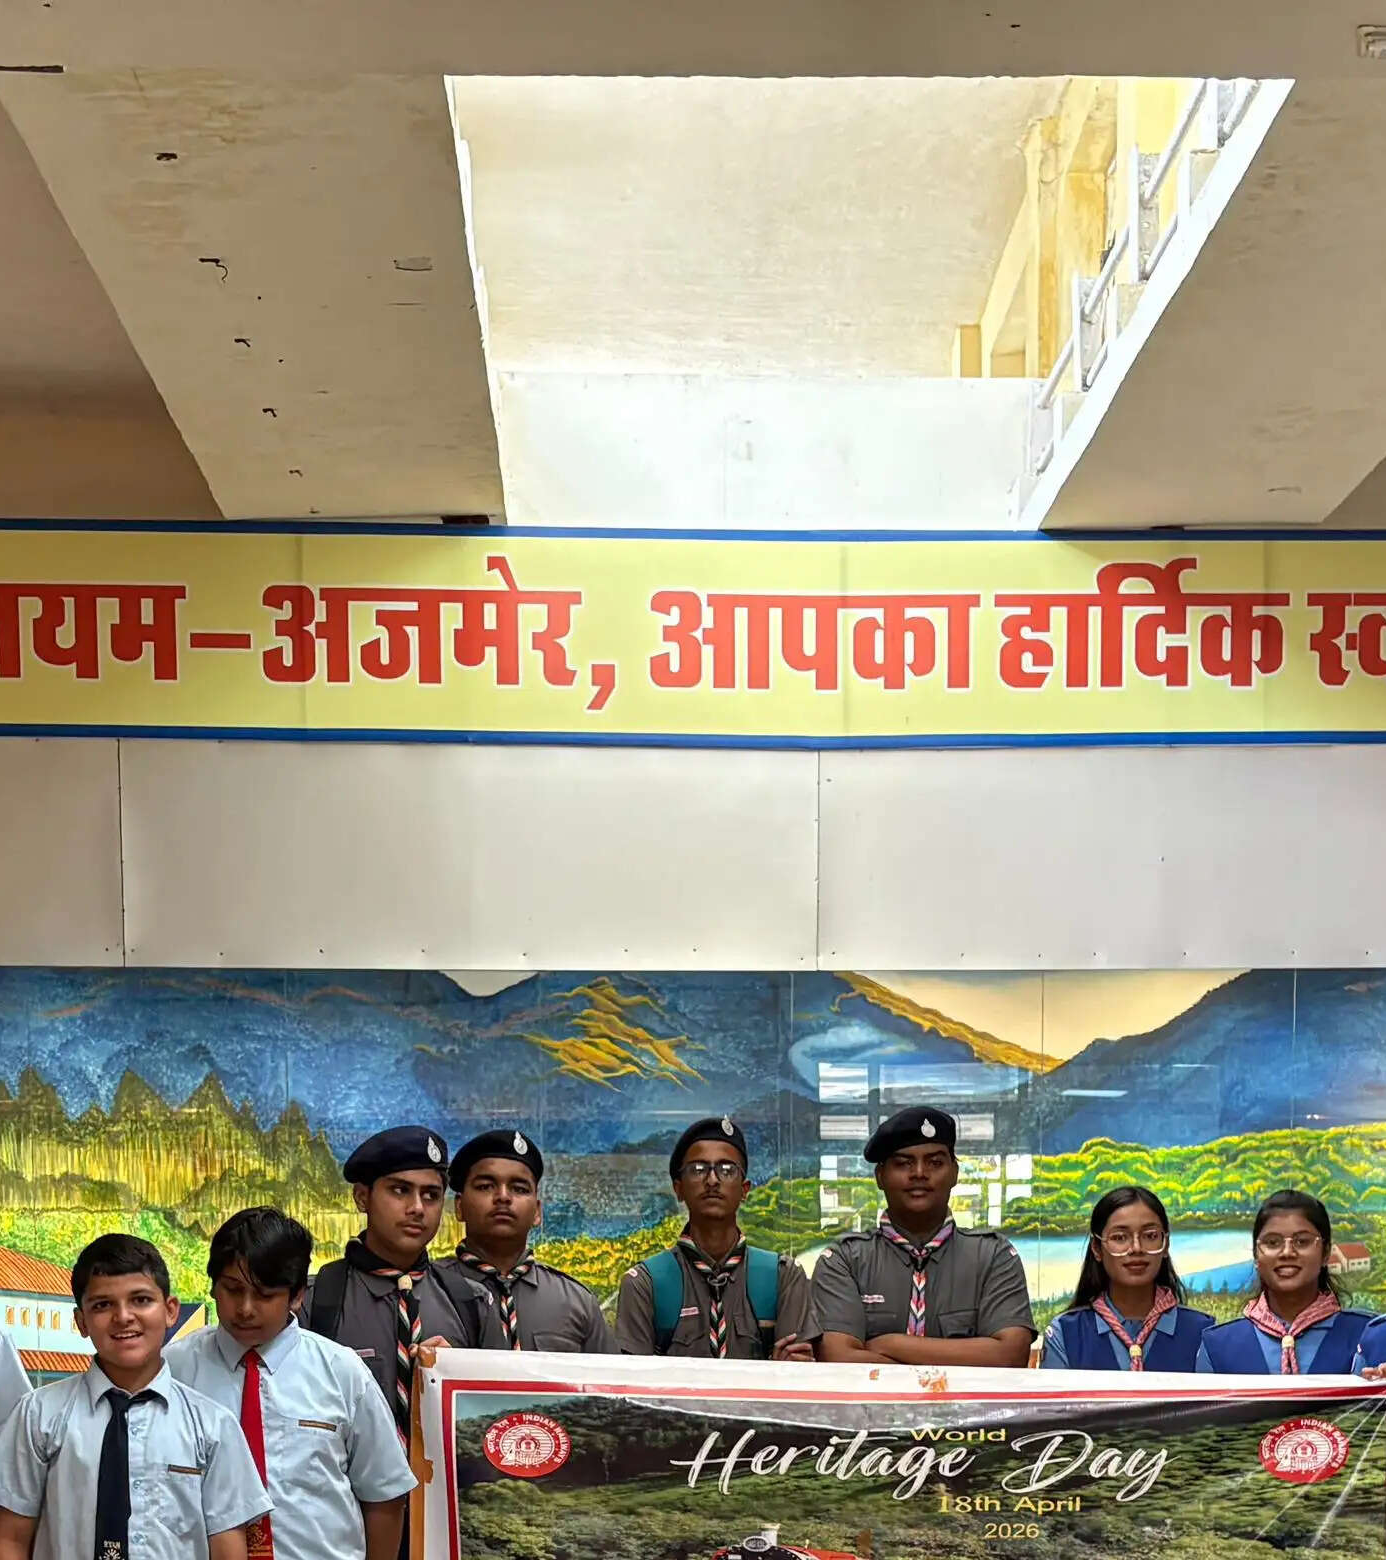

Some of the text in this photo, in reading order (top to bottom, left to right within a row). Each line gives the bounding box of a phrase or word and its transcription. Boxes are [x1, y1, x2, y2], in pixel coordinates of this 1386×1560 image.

[649, 590, 981, 690] आपका
[994, 557, 1290, 688] हार्दिक
[522, 1414, 556, 1429] INDIAN
[1300, 1418, 1335, 1433] INDIAN
[909, 1427, 1006, 1442] World
[670, 1428, 1181, 1502] Heritage Day
[938, 1495, 1081, 1516] 18th April
[983, 1522, 1040, 1540] 2026
